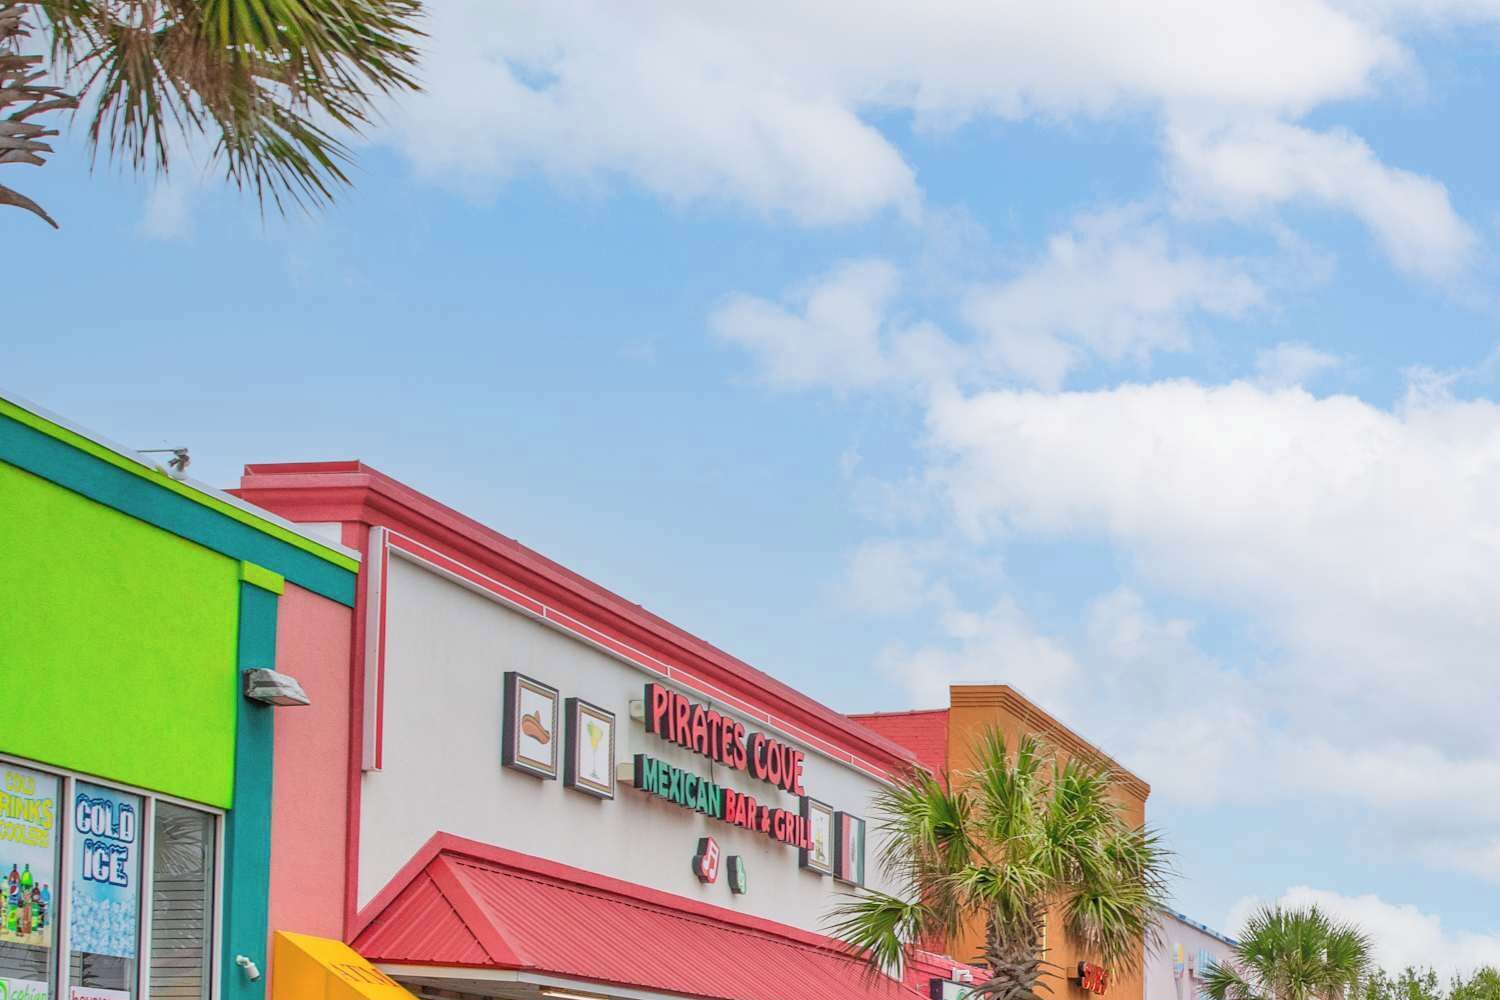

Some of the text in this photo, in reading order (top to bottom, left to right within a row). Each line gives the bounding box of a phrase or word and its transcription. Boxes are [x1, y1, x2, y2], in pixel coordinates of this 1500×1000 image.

[645, 683, 806, 797] PIRATES COVE
[75, 793, 135, 844] COLD
[636, 755, 815, 850] MEXICAN BAR & GRILL
[82, 838, 128, 888] ICE
